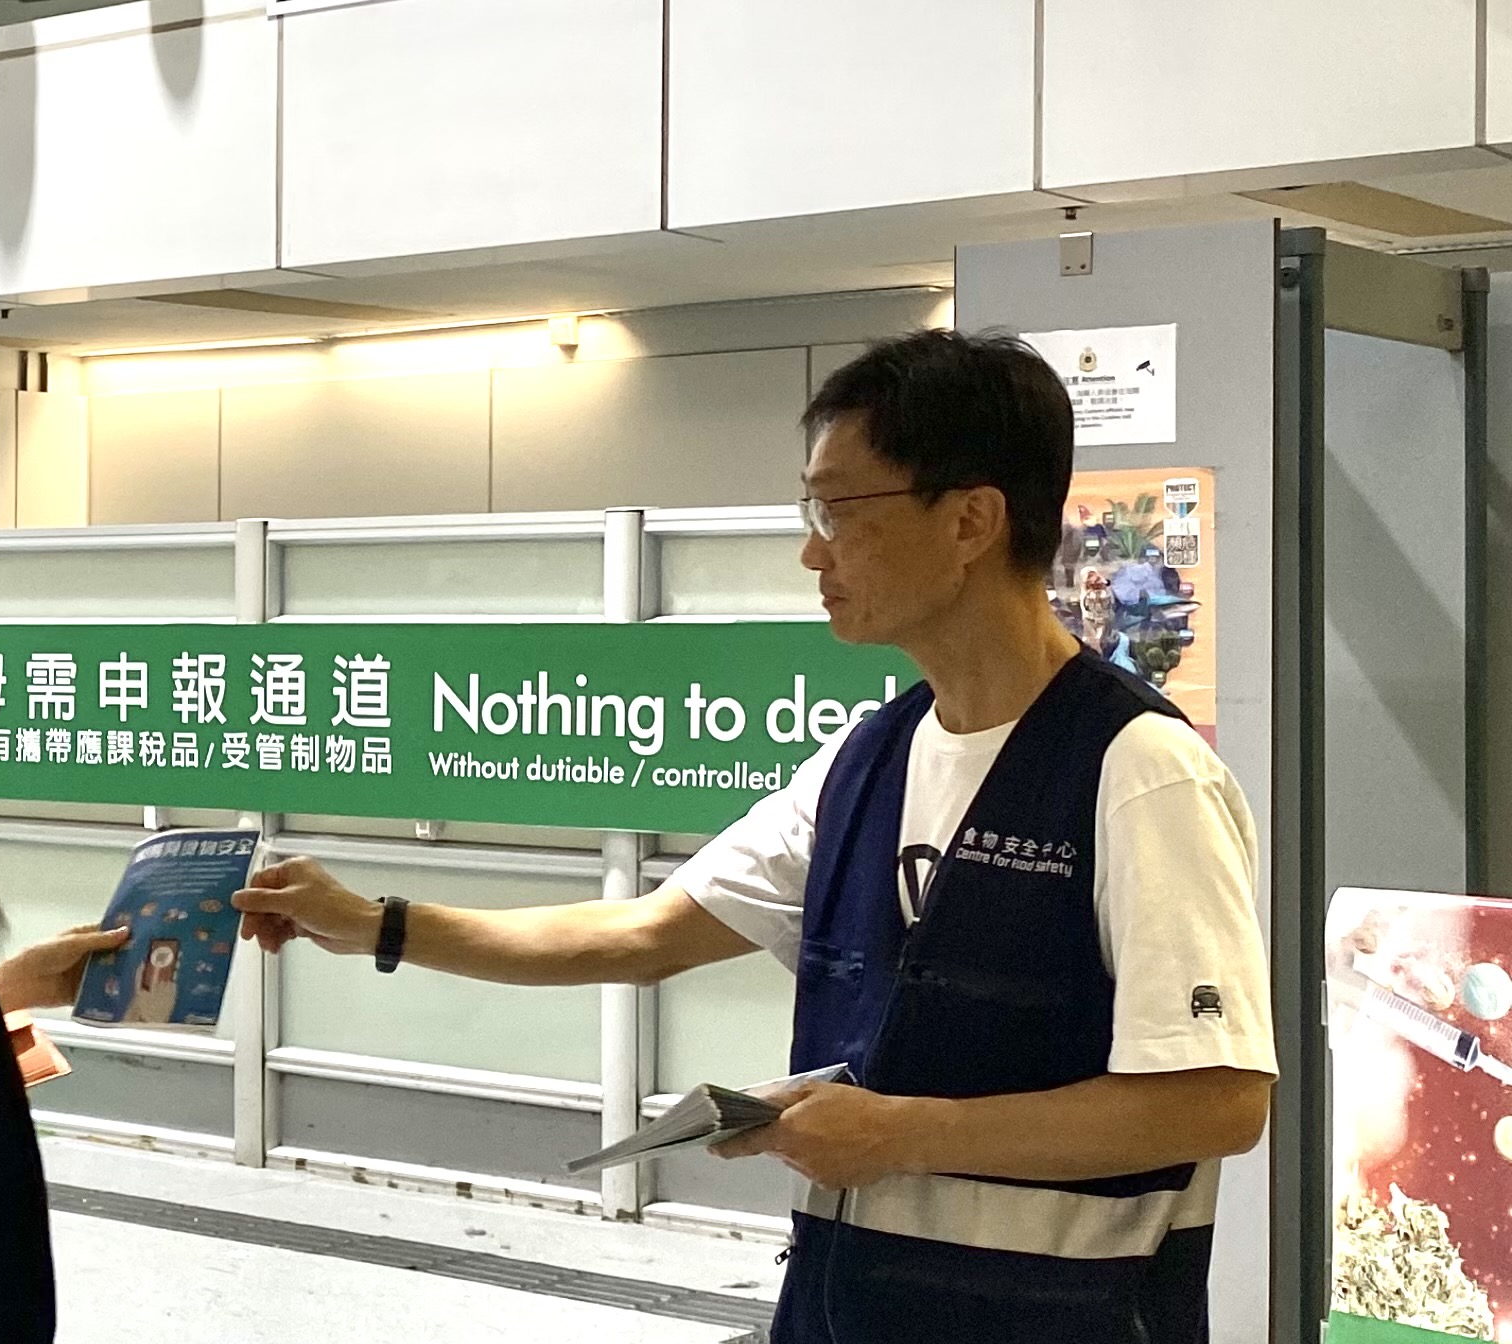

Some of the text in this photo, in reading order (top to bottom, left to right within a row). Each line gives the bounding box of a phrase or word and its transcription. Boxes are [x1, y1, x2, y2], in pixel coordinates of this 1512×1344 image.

[433, 671, 665, 755] Nothing
[684, 683, 747, 741] to
[428, 751, 520, 781] Without
[526, 756, 625, 785] dutiable
[631, 759, 646, 787] /
[652, 762, 781, 791] controlled
[955, 847, 1073, 878] Centre for Food Safety
